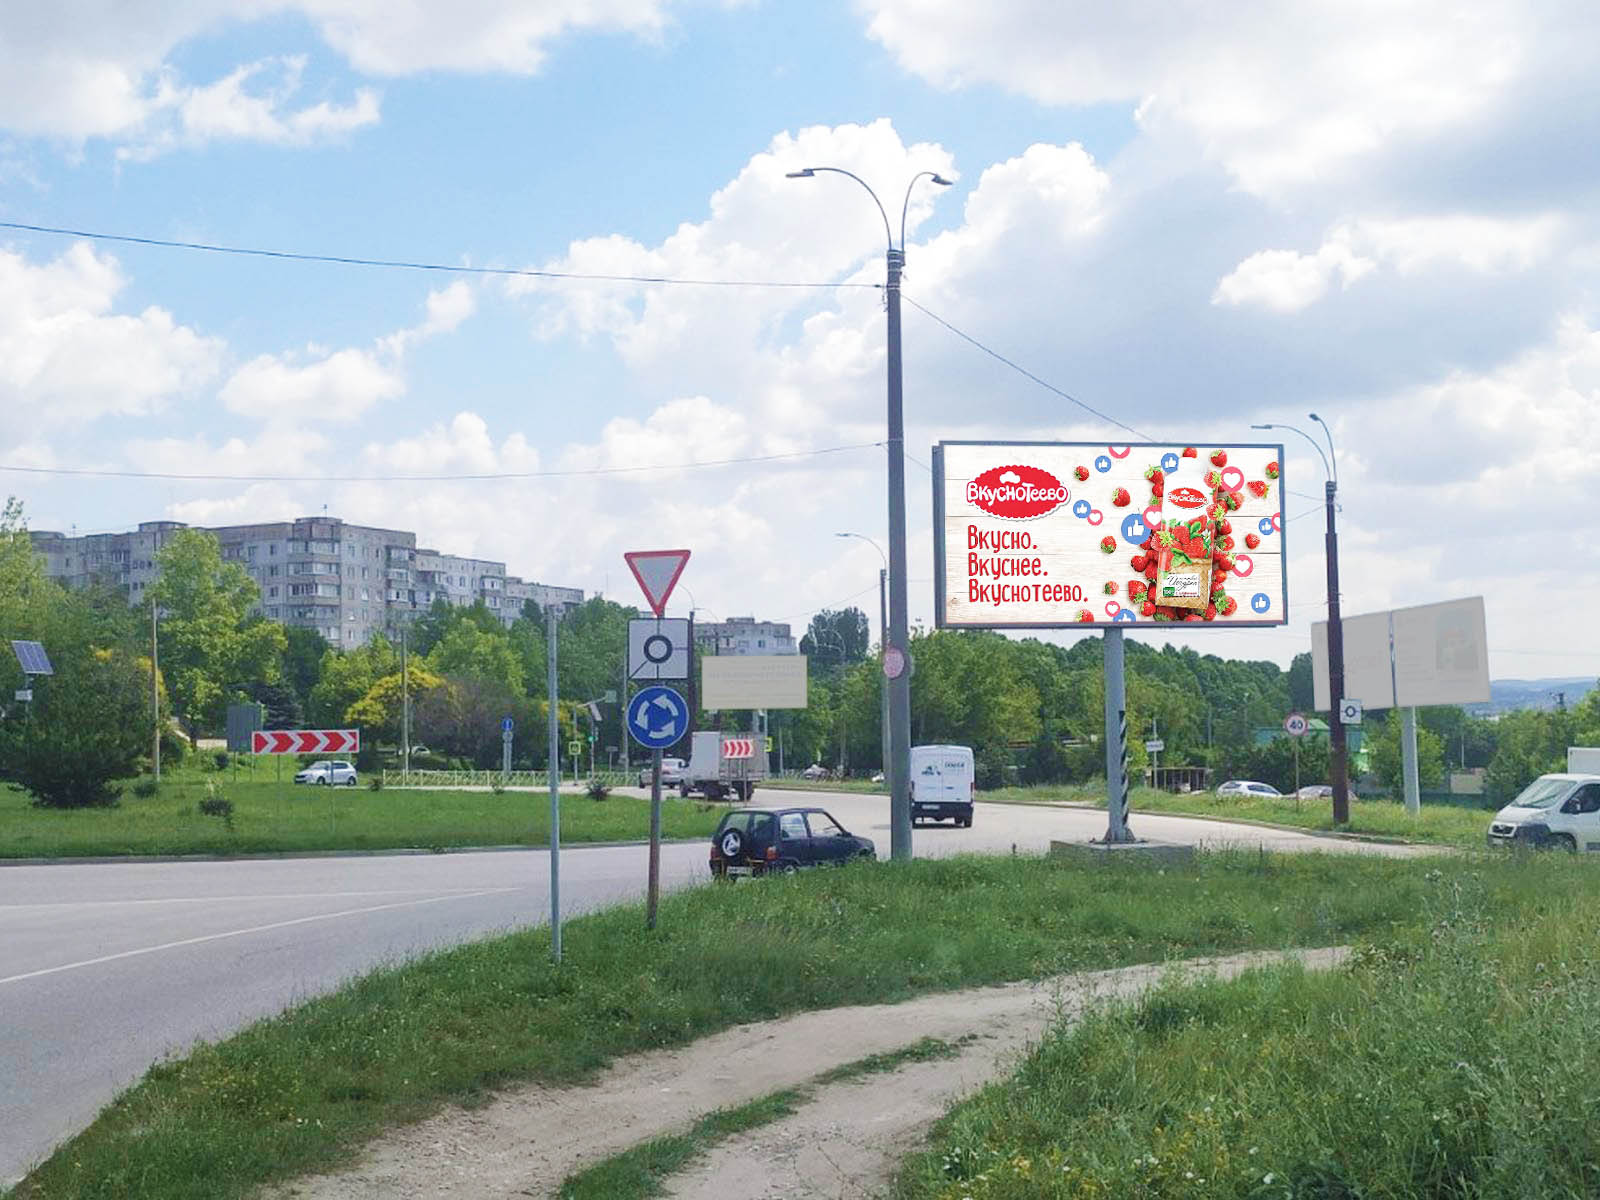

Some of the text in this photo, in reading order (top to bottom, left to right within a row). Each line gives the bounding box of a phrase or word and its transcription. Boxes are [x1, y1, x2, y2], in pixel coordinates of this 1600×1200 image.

[967, 524, 1038, 554] Вкусно.
[968, 551, 1049, 581] Вкуснее.
[968, 578, 1089, 607] Вкуснотеево.
[1289, 719, 1304, 730] 40
